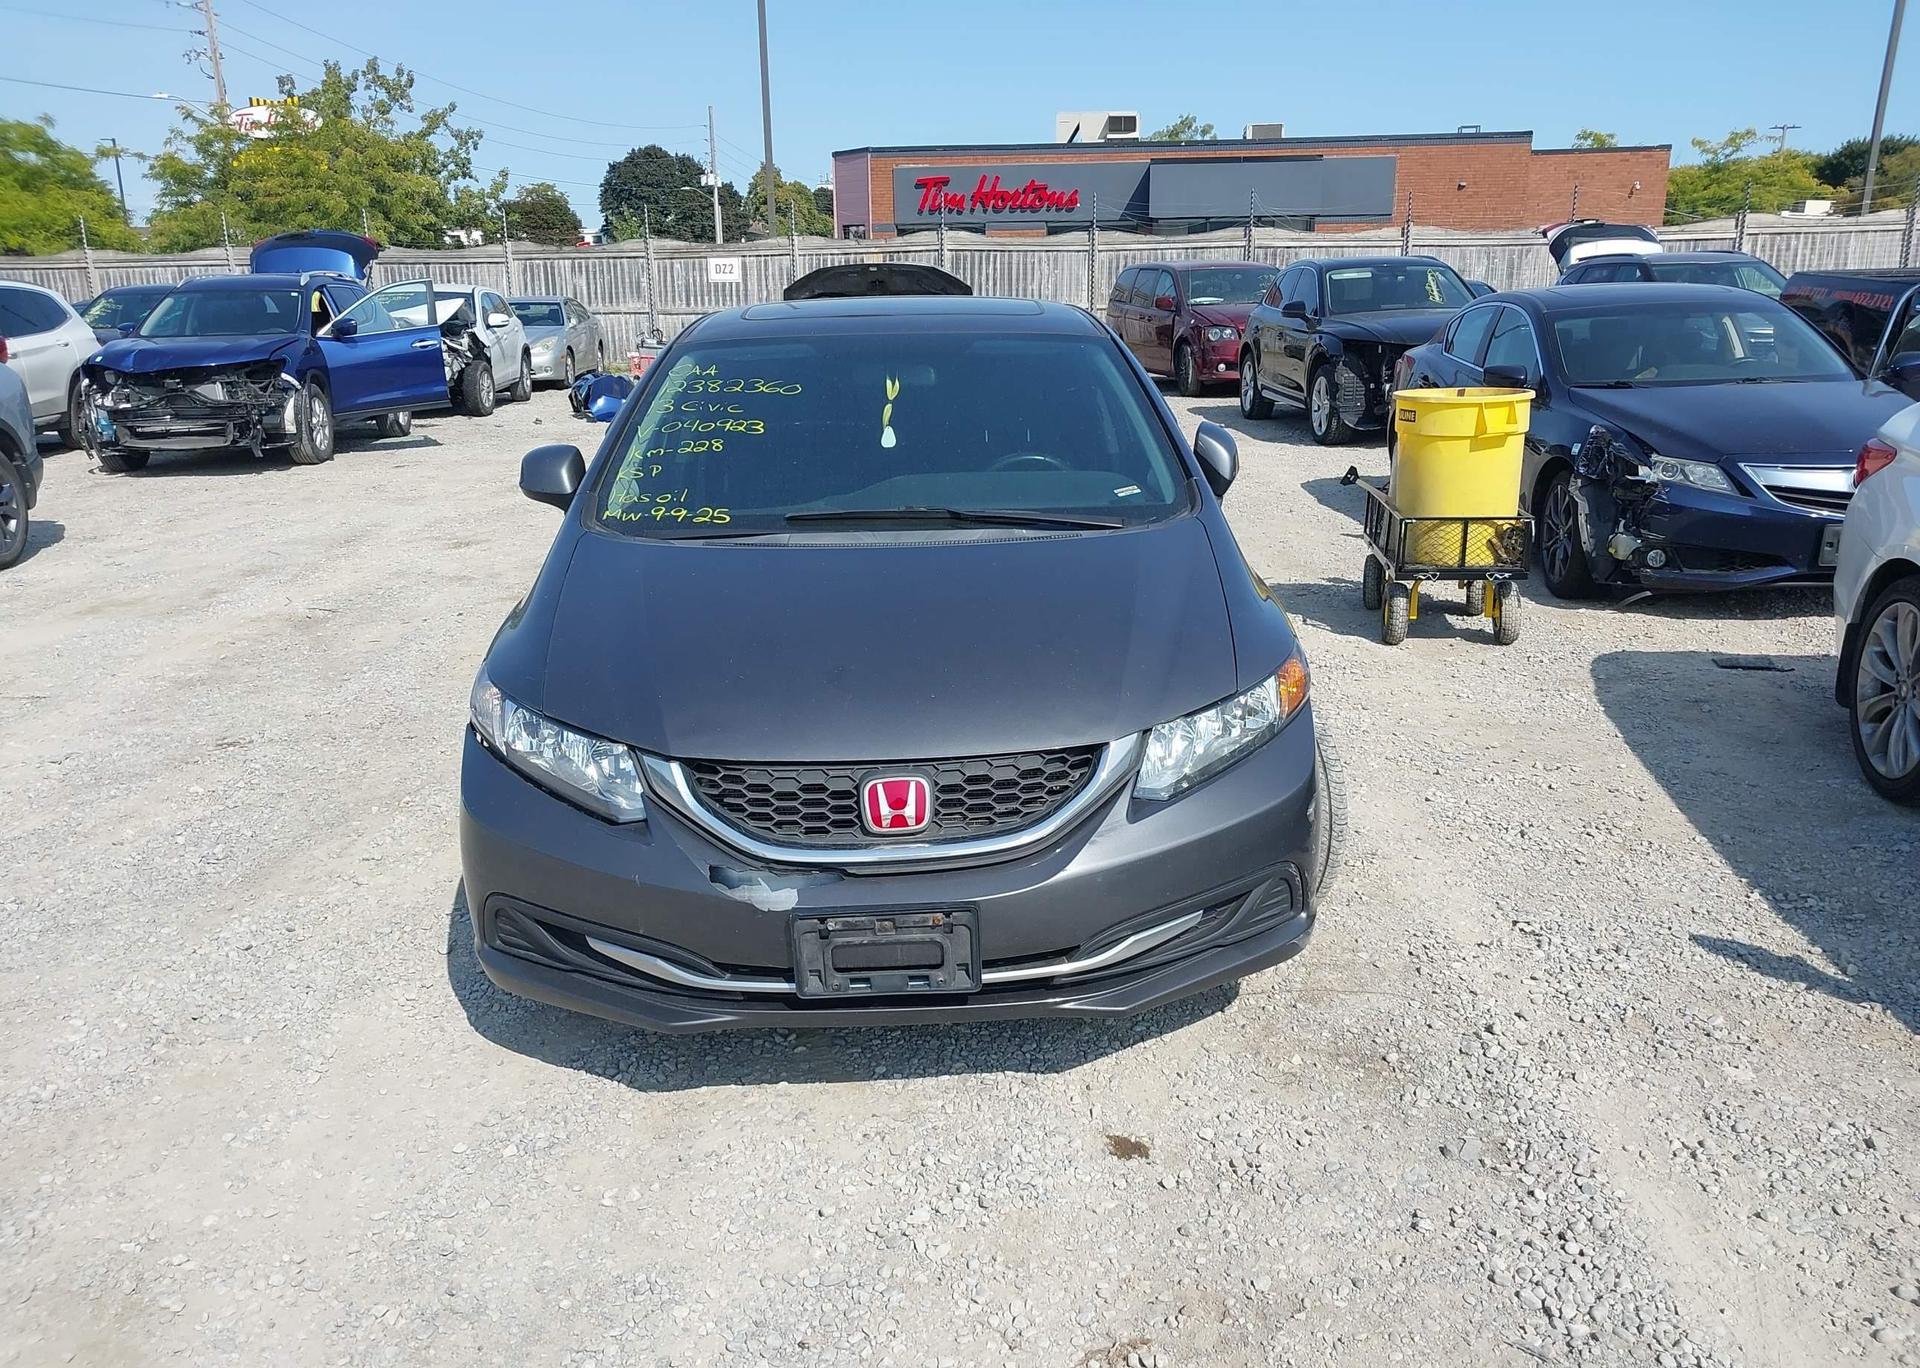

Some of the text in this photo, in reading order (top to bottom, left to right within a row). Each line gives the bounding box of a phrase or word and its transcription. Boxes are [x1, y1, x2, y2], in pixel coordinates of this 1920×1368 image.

[914, 174, 1080, 214] Tim Hortons
[715, 263, 734, 275] DZ2
[681, 400, 744, 413] Civic
